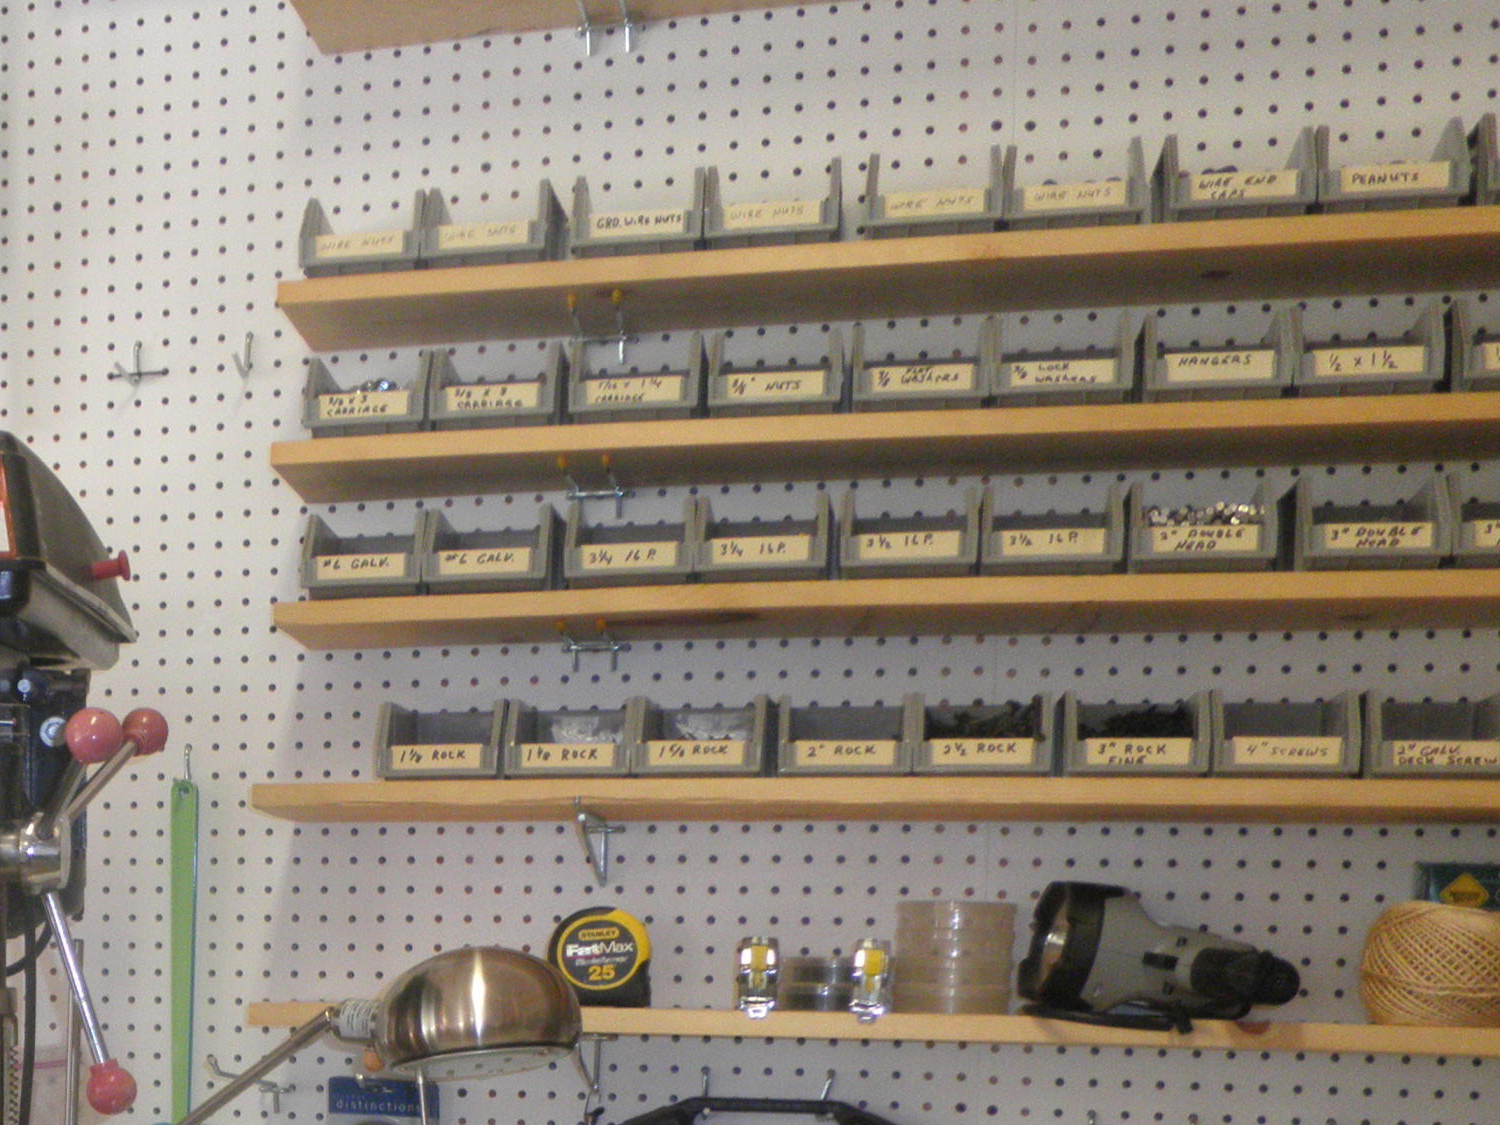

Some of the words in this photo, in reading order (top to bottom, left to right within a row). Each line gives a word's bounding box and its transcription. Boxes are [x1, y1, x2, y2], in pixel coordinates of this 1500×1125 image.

[1351, 172, 1420, 184] PEANUTS
[1034, 190, 1068, 201] WIRE
[1076, 188, 1111, 199] NUTS
[654, 213, 682, 225] NUTS
[730, 209, 762, 220] WIRE
[773, 206, 804, 217] NUTS
[1178, 353, 1253, 367] HANGERS
[765, 380, 802, 392] NUTS
[326, 403, 389, 417] CARRIAGE
[1188, 528, 1246, 540] DOUBLE
[1355, 526, 1426, 539] DOUBLE
[561, 747, 598, 761] ROCK
[691, 743, 729, 756] ROCK
[834, 743, 877, 756] ROCK
[976, 742, 1017, 754] ROCK
[1125, 742, 1167, 754] ROCK
[1271, 746, 1329, 757] SCREWS
[431, 749, 467, 762] ROCK
[581, 929, 618, 940] STANLEY
